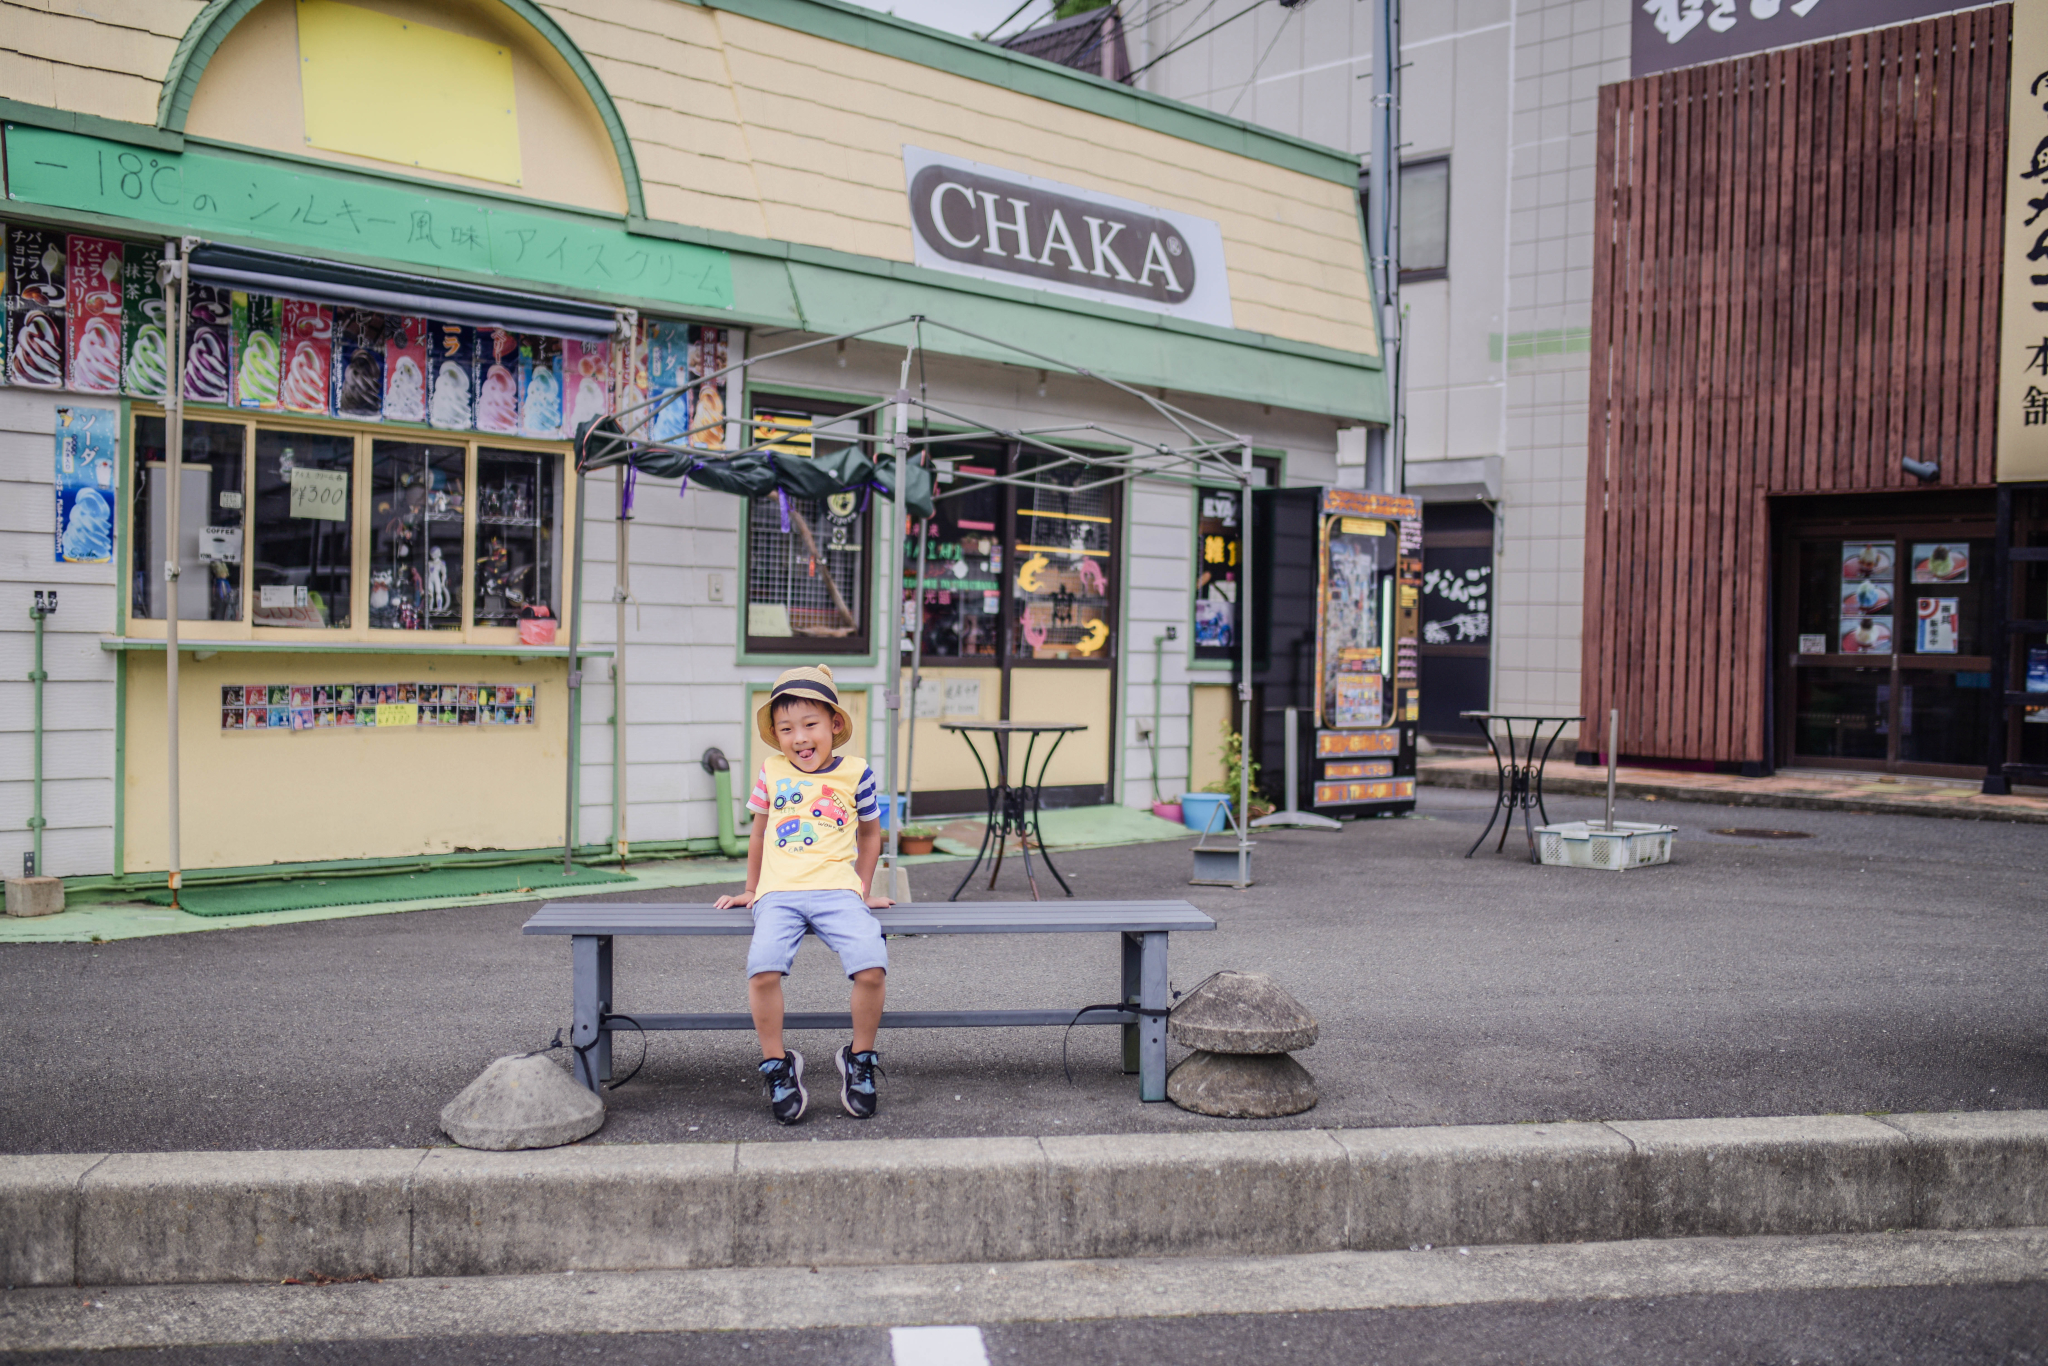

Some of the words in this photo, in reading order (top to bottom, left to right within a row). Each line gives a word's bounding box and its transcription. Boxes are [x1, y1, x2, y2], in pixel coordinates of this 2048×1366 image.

[26, 232, 42, 280] バニラ&
[930, 181, 1184, 293] CHAKA
[12, 230, 27, 309] チョコレート
[72, 240, 88, 317] ストロベリー
[87, 242, 103, 287] バニラ&
[125, 262, 141, 300] 抹茶
[664, 328, 677, 371] ソーダ
[81, 414, 99, 467] ソーダ
[206, 527, 235, 535] COFFEE
